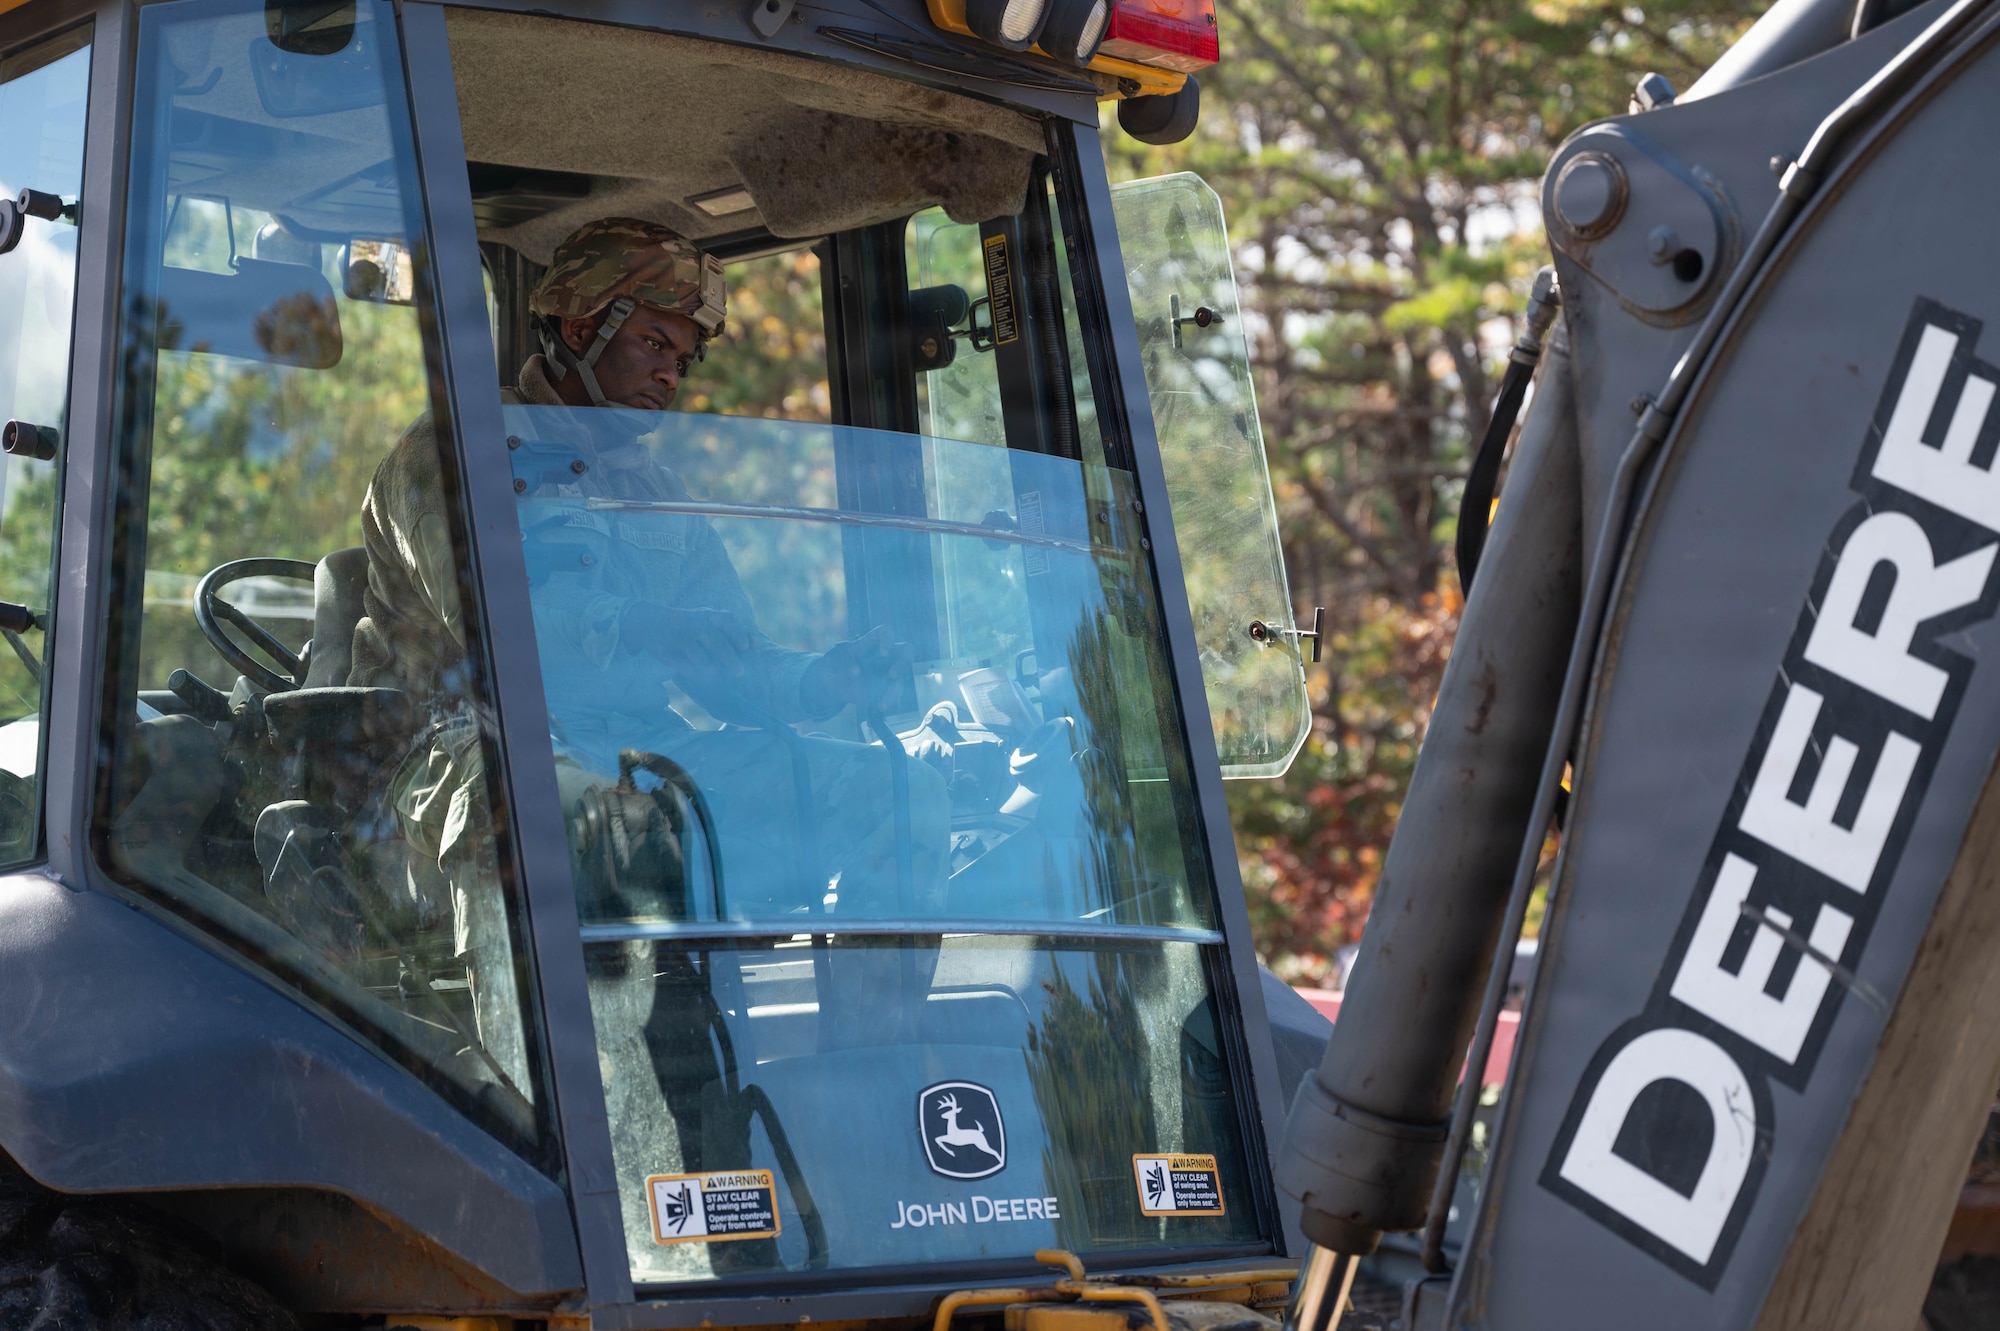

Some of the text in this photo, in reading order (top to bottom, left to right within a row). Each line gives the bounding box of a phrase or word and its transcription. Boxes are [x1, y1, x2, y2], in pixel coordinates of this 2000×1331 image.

[561, 509, 596, 528] NSON
[652, 533, 684, 551] FORCE
[1559, 322, 2000, 1267] DEERE
[1179, 1158, 1214, 1168] WARNING
[717, 1174, 769, 1188] WARNING
[1172, 1173, 1209, 1181] STAY CLEAR
[1180, 1182, 1196, 1190] swing
[705, 1191, 760, 1203] STAY CLEAR
[1175, 1191, 1218, 1200] Operate controls
[706, 1202, 759, 1213] of swing area.
[1177, 1200, 1189, 1208] only
[708, 1211, 771, 1224] Operate controls
[890, 1195, 1060, 1229] JOHN DEERE
[709, 1222, 727, 1232] only
[728, 1221, 746, 1231] from
[747, 1220, 766, 1229] seat.
